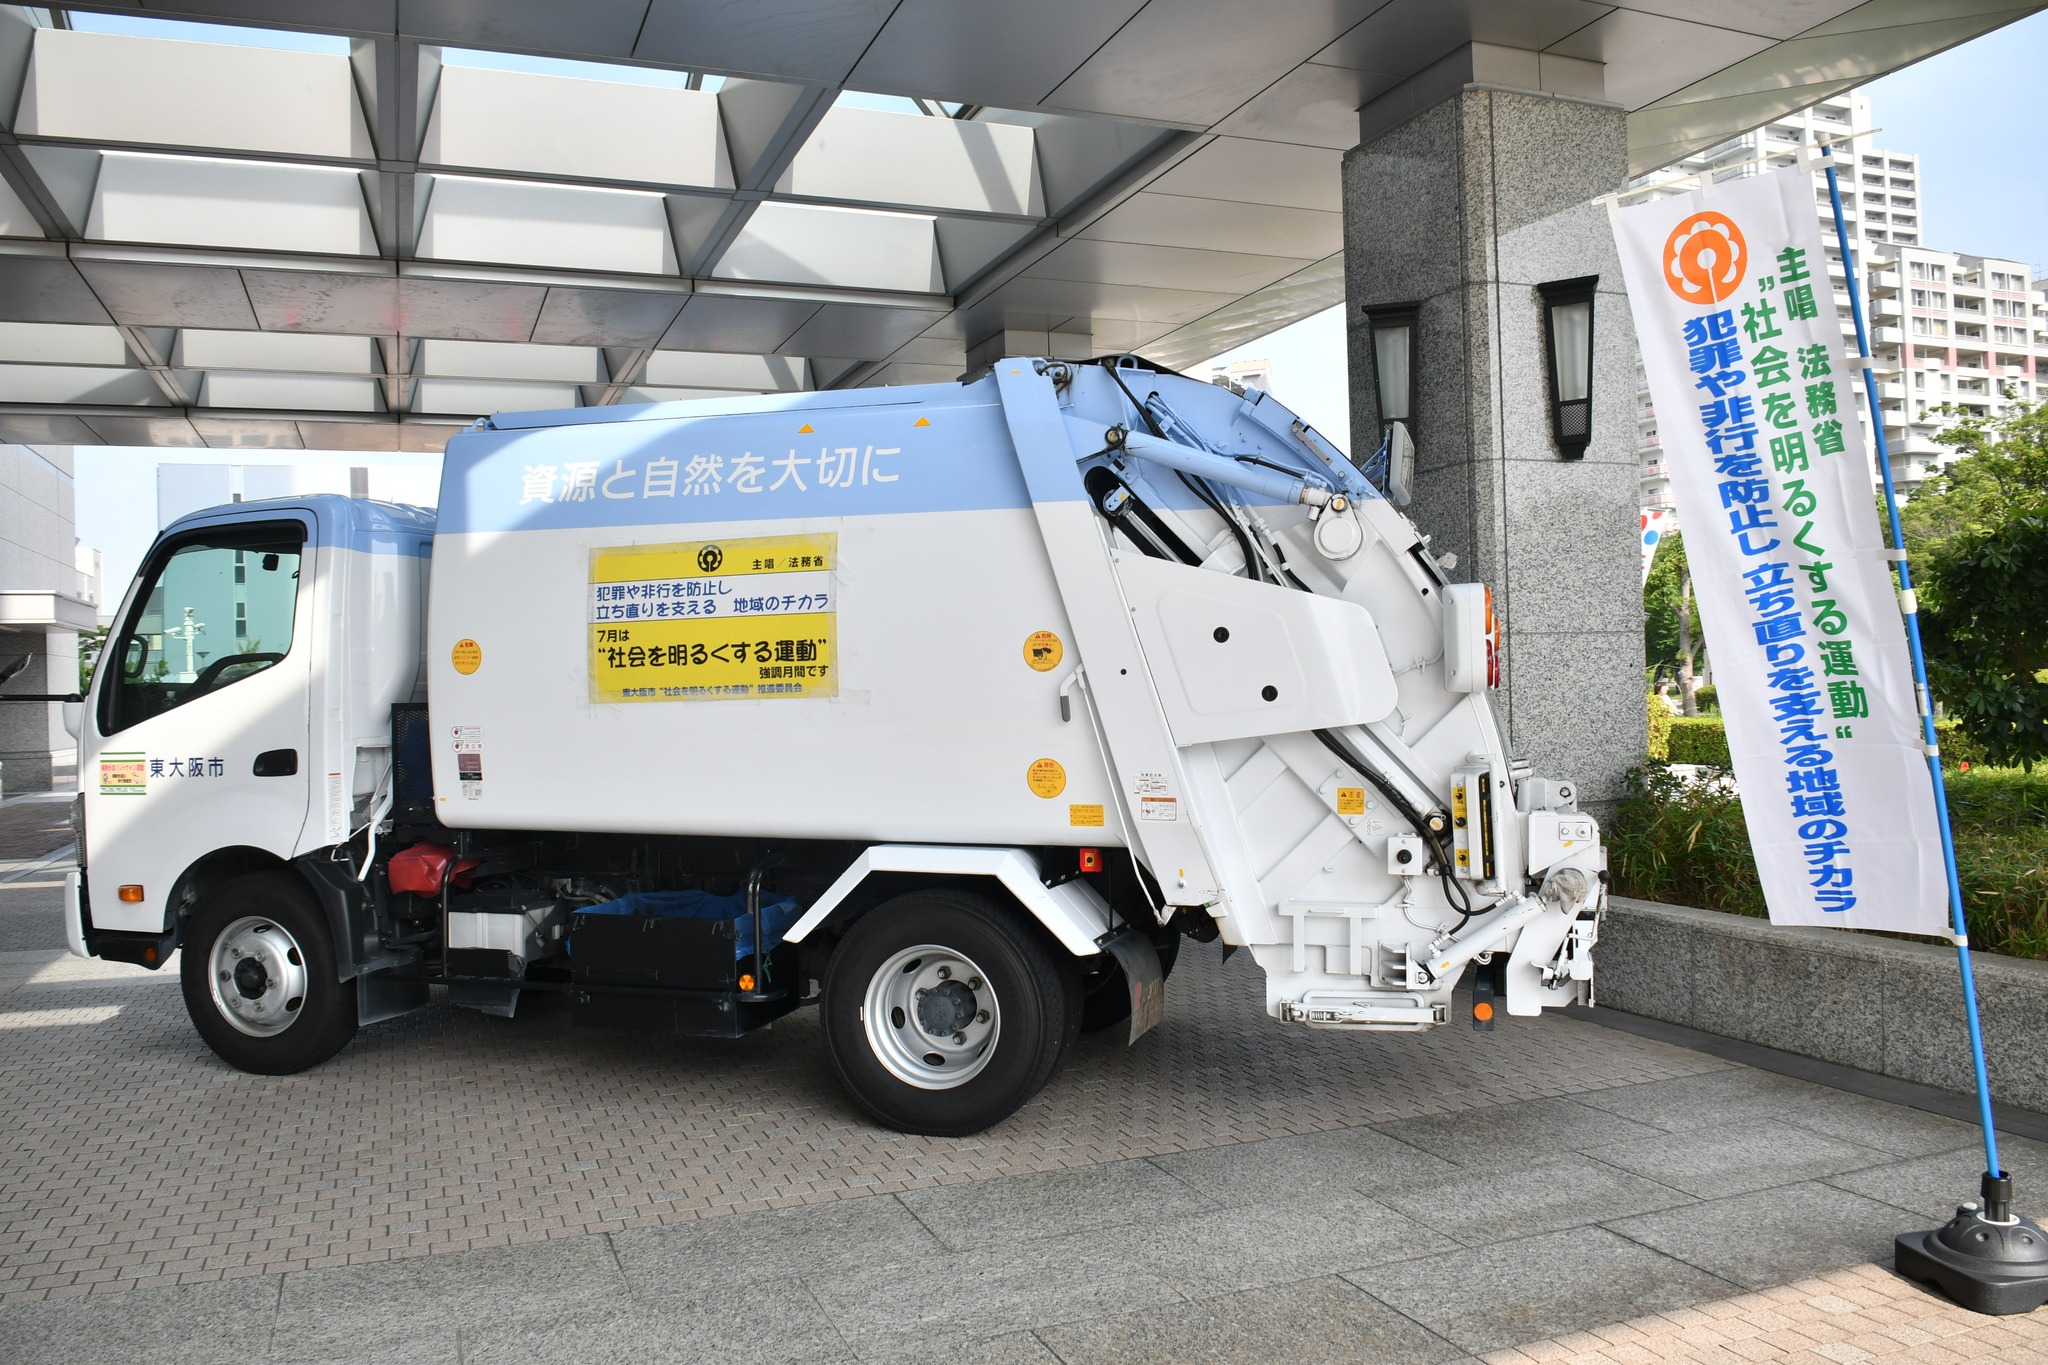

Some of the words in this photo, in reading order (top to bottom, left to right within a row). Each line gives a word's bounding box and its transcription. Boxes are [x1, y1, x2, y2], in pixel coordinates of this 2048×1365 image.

[1776, 247, 1818, 321] 主唱
[1797, 344, 1845, 457] 法務省
[518, 445, 902, 505] 資源と自然を大切に
[596, 580, 733, 602] 犯罪や非行を防止し
[596, 599, 717, 620] 立ち直りを支える
[733, 594, 829, 613] 地域のチカラ
[759, 664, 829, 679] 強調月間です
[149, 756, 225, 779] 東大阪市
